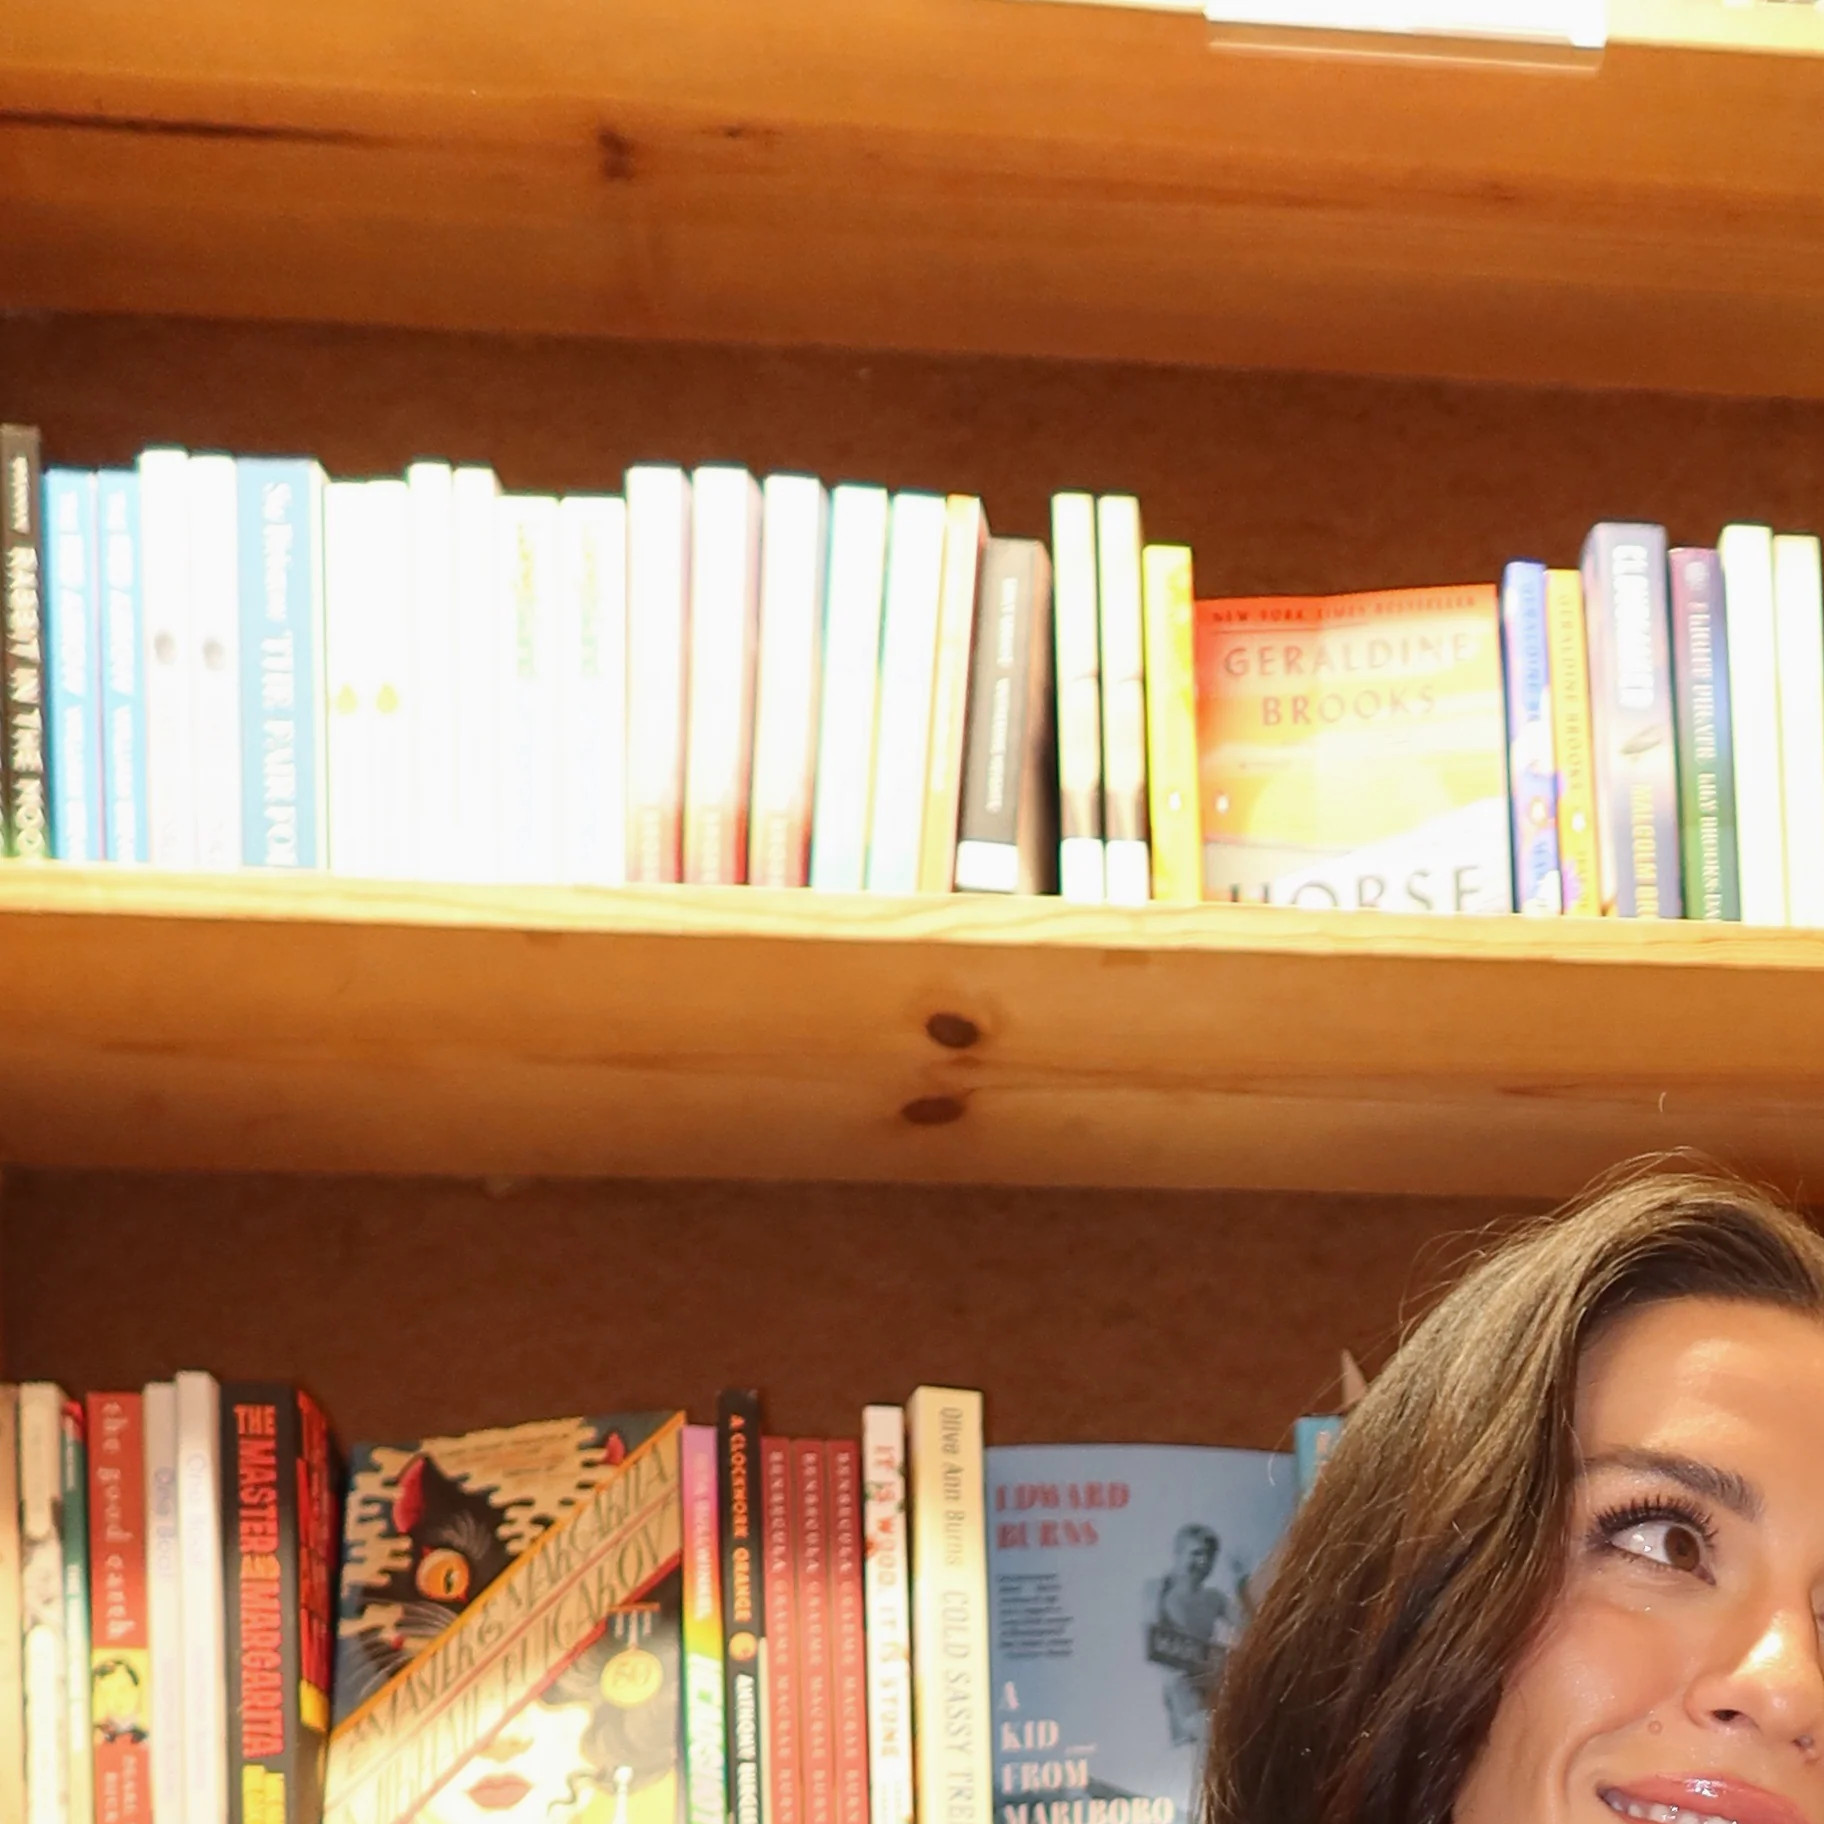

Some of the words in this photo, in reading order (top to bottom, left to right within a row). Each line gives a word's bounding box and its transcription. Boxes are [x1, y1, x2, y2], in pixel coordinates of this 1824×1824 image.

[1224, 632, 1473, 678] GERALDINE
[1261, 684, 1436, 727] BROOKS
[15, 777, 45, 857] MOO
[233, 1404, 277, 1436] THE
[940, 1407, 965, 1453] Olive
[237, 1438, 281, 1552] MASTER
[730, 1434, 747, 1537] CLOCKWORK
[942, 1462, 967, 1501] Ann
[997, 1482, 1131, 1512] EDWARD
[944, 1509, 969, 1567] Burns
[997, 1520, 1099, 1549] BURNS
[733, 1548, 752, 1621] ORANGE
[942, 1590, 971, 1659] COLD
[237, 1582, 284, 1759] MARGARITA
[945, 1669, 974, 1755] SASSY
[1002, 1681, 1020, 1711] A
[1001, 1720, 1059, 1753] KID
[1002, 1759, 1089, 1794] FROM
